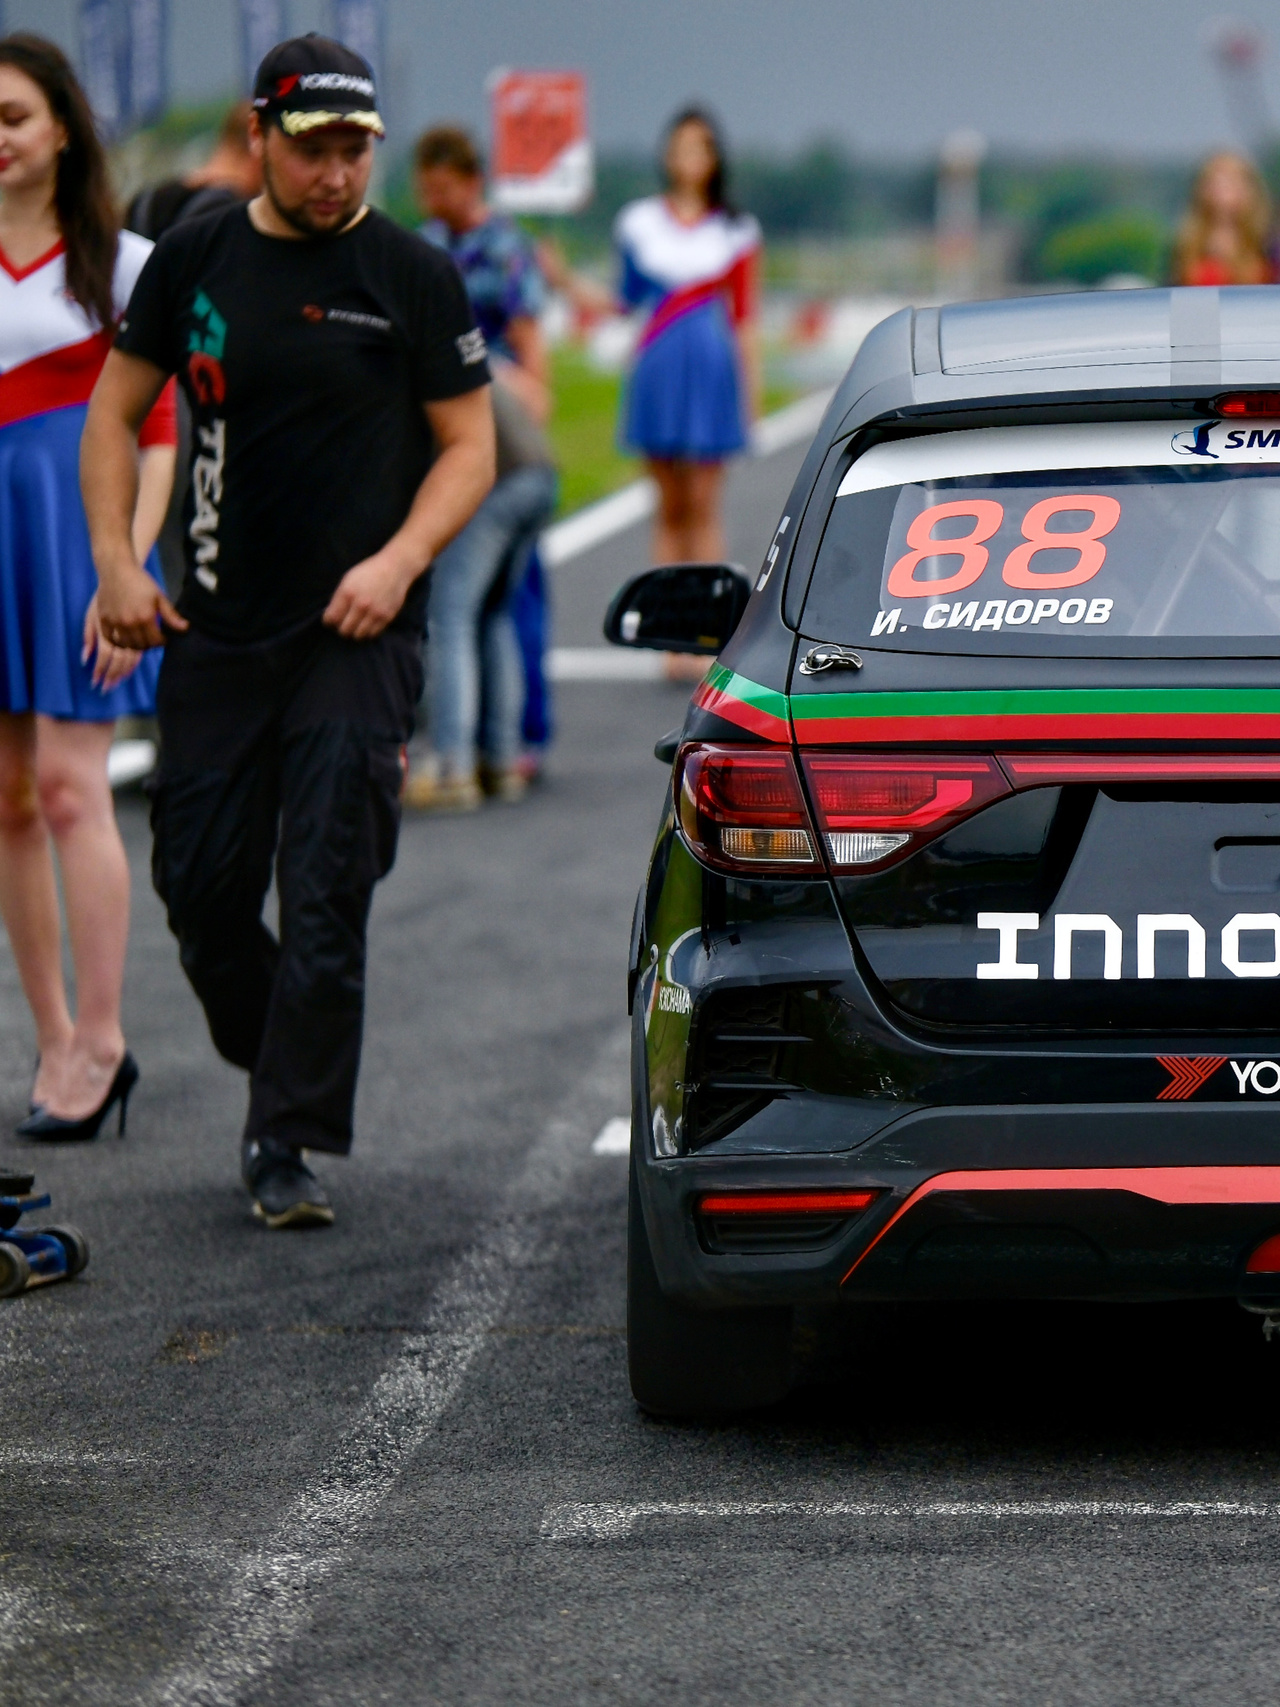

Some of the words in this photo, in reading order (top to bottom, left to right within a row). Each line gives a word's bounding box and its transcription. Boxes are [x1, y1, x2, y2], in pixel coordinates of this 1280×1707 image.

[189, 417, 226, 592] TEAM
[888, 494, 1121, 598] 88
[870, 608, 908, 636] И.
[922, 598, 1115, 631] СИДОРОВ
